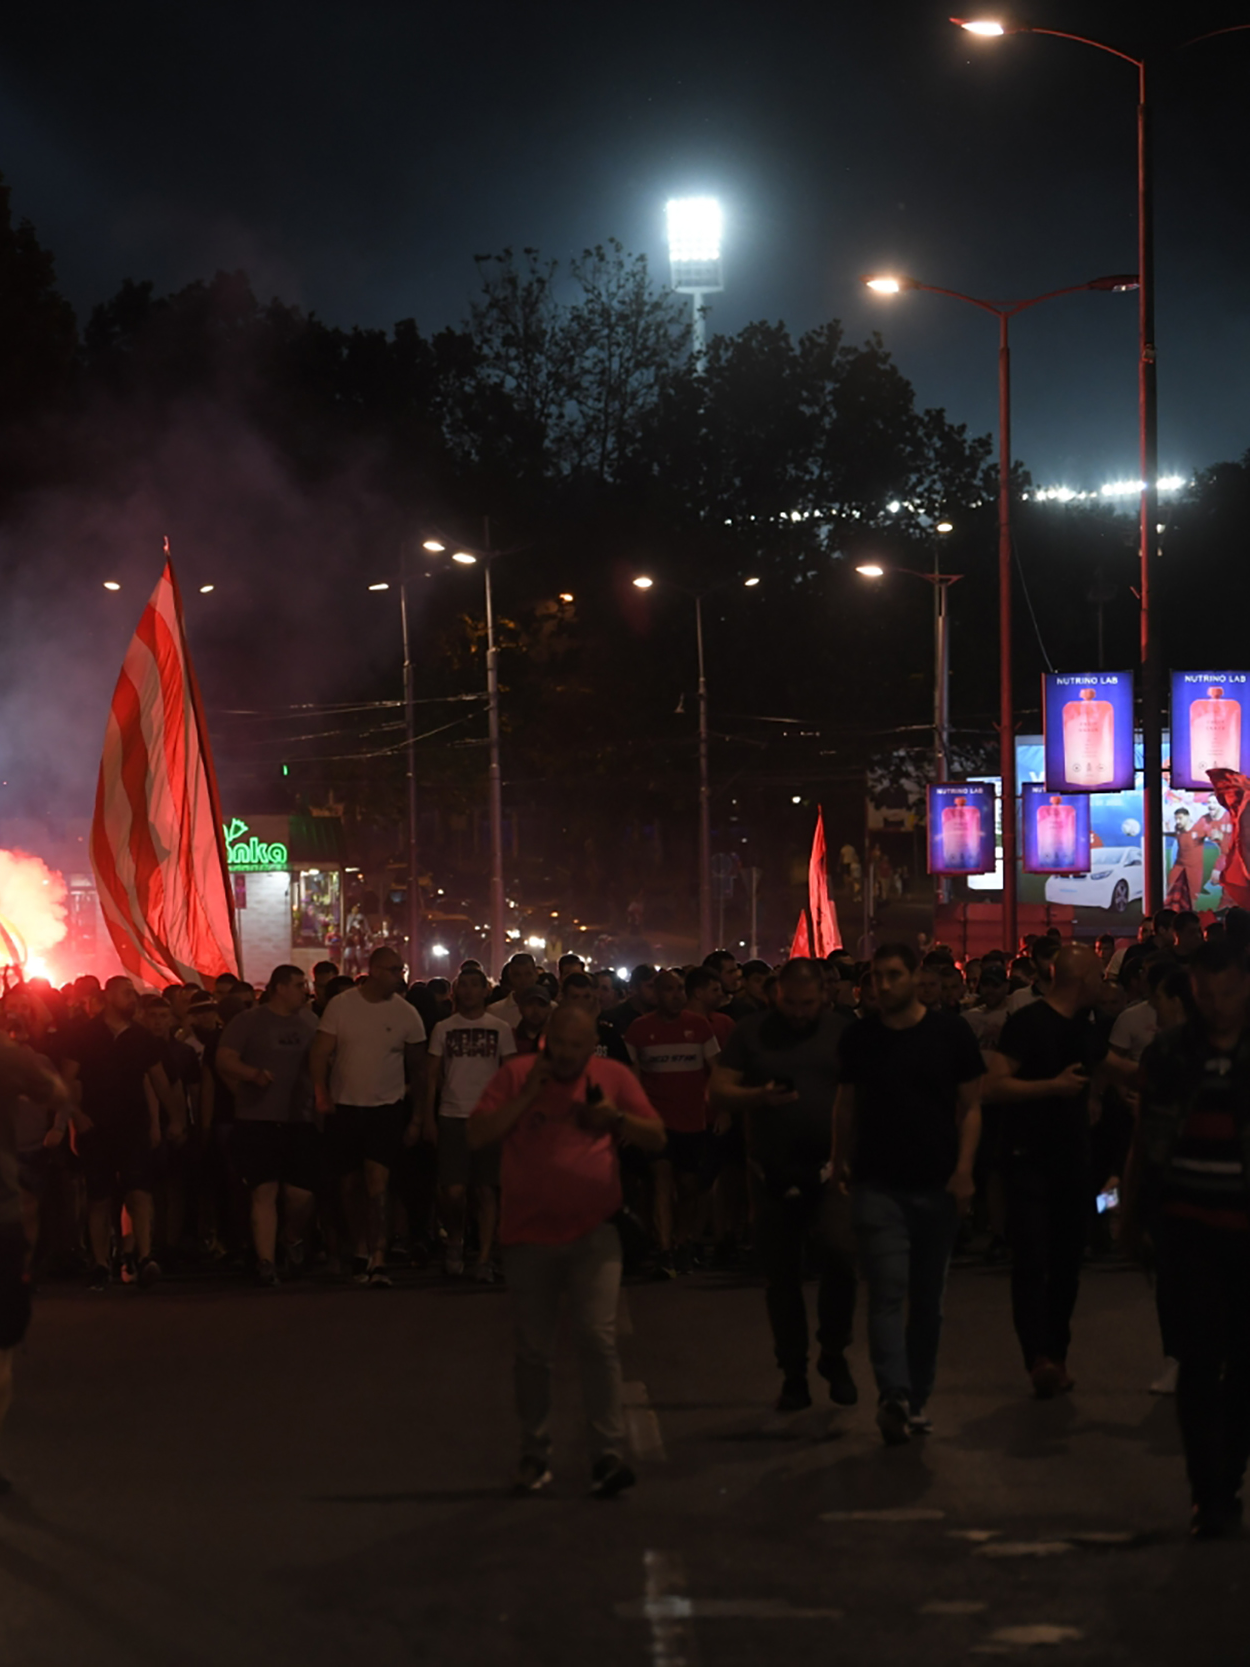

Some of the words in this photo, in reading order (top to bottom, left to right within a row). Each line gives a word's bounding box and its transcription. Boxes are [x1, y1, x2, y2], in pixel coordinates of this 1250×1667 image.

[1056, 677, 1098, 685] NUTRINO
[1100, 676, 1118, 685] LAB
[1184, 675, 1226, 683] NUTRINO
[1228, 675, 1247, 683] LAB
